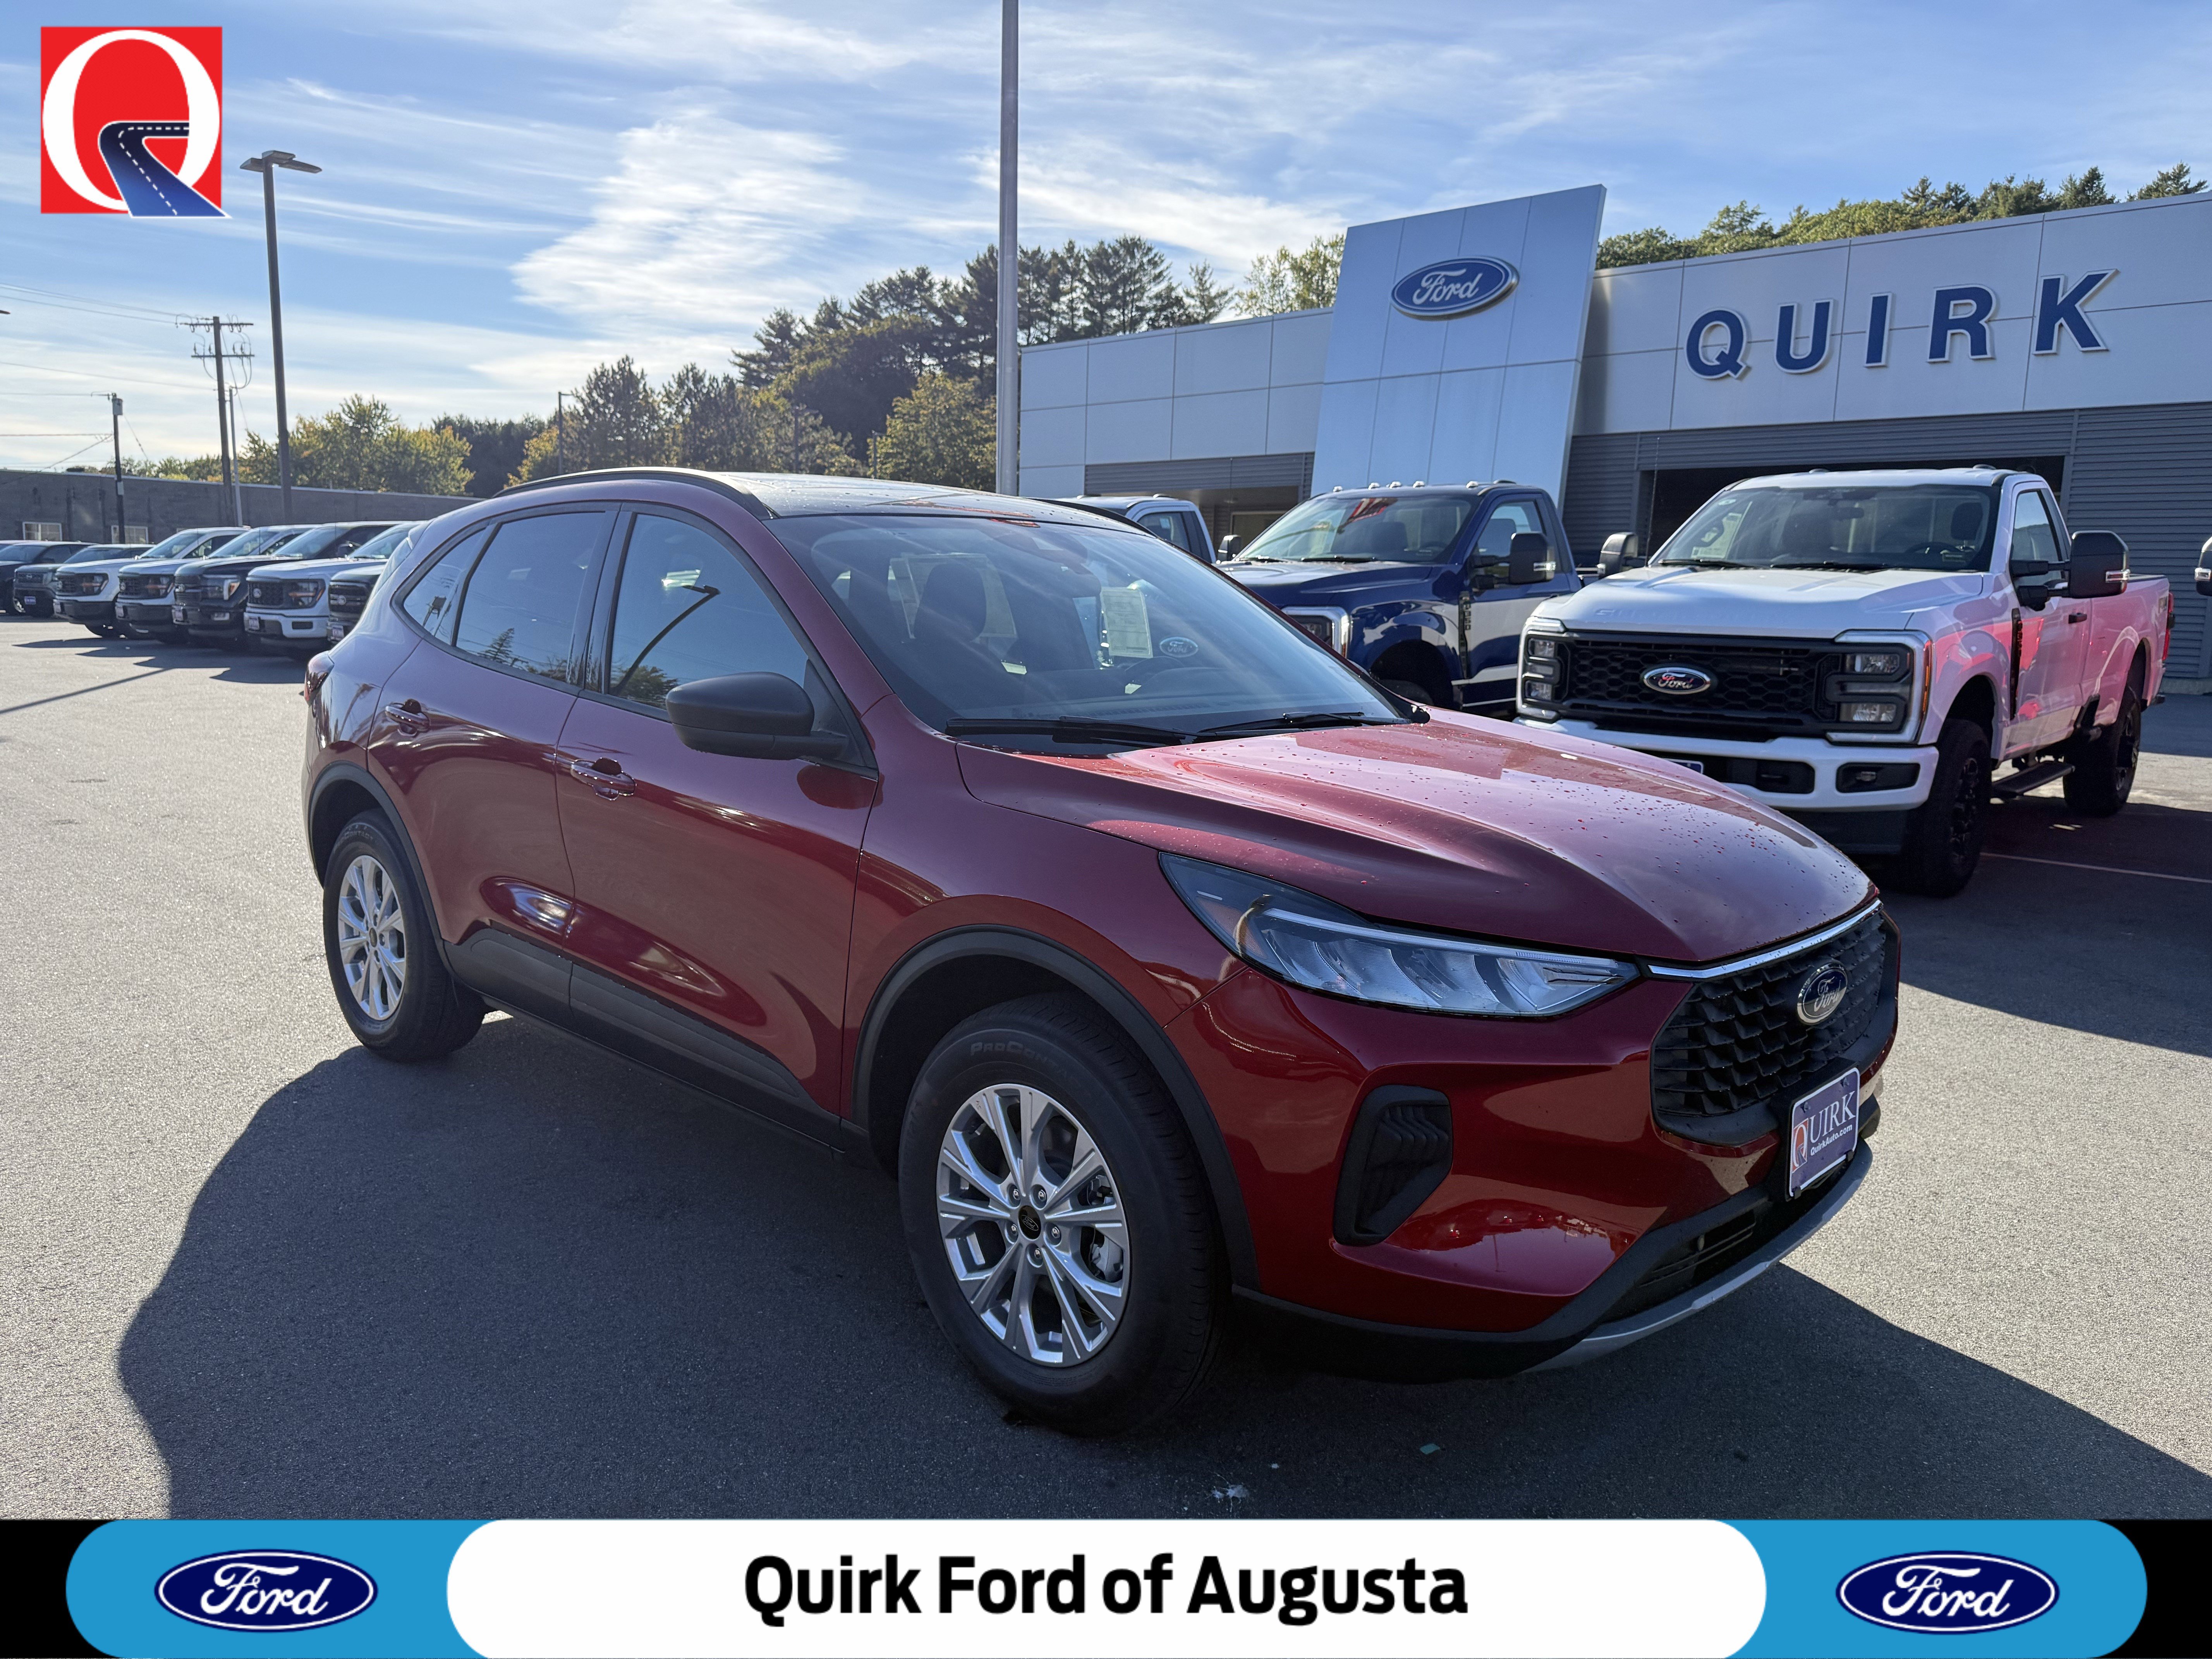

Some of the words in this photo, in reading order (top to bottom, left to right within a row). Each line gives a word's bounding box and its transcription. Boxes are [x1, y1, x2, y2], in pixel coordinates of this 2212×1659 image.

[1412, 268, 1483, 304] Ford
[1686, 268, 2118, 380] QUIRK
[1167, 641, 1188, 653] Ford
[1658, 672, 1694, 689] Ford
[1814, 976, 1842, 1012] Ford
[1793, 1091, 1856, 1168] QUIRK
[1810, 1124, 1852, 1156] QuirkAuto.com
[1023, 1217, 1036, 1229] Ford
